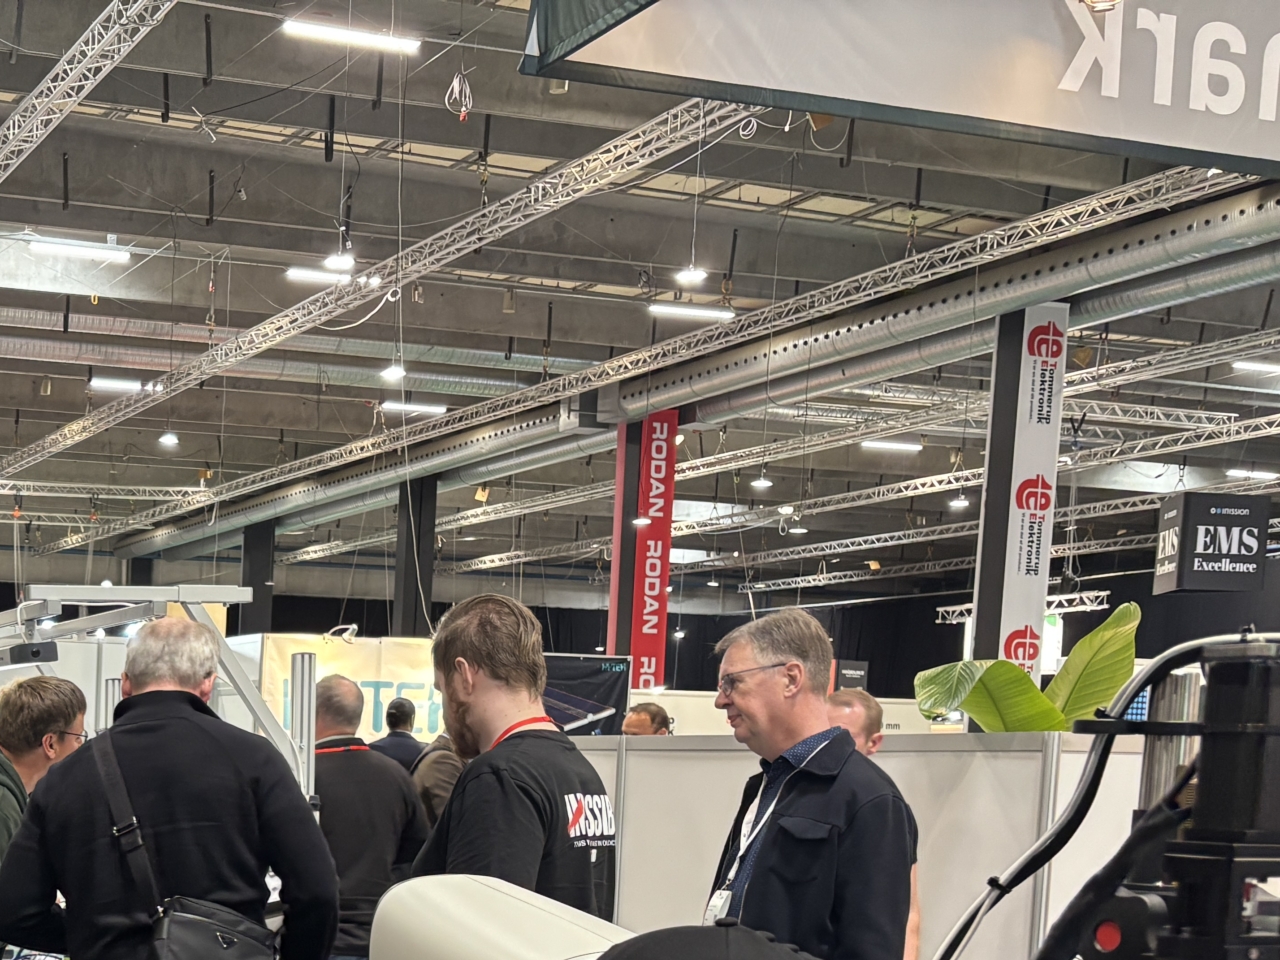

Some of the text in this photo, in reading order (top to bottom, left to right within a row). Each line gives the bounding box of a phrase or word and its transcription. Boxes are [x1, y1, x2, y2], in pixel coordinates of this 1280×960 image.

[1037, 360, 1049, 424] Elektronik
[1044, 361, 1058, 425] Tommerup
[648, 421, 669, 518] RODAN
[1025, 513, 1038, 576] Elektronik
[1032, 514, 1046, 576] Tommerup
[1157, 526, 1179, 559] EMS
[1193, 557, 1257, 573] Excellence
[1194, 525, 1259, 556] EMS
[641, 539, 663, 635] RODAN
